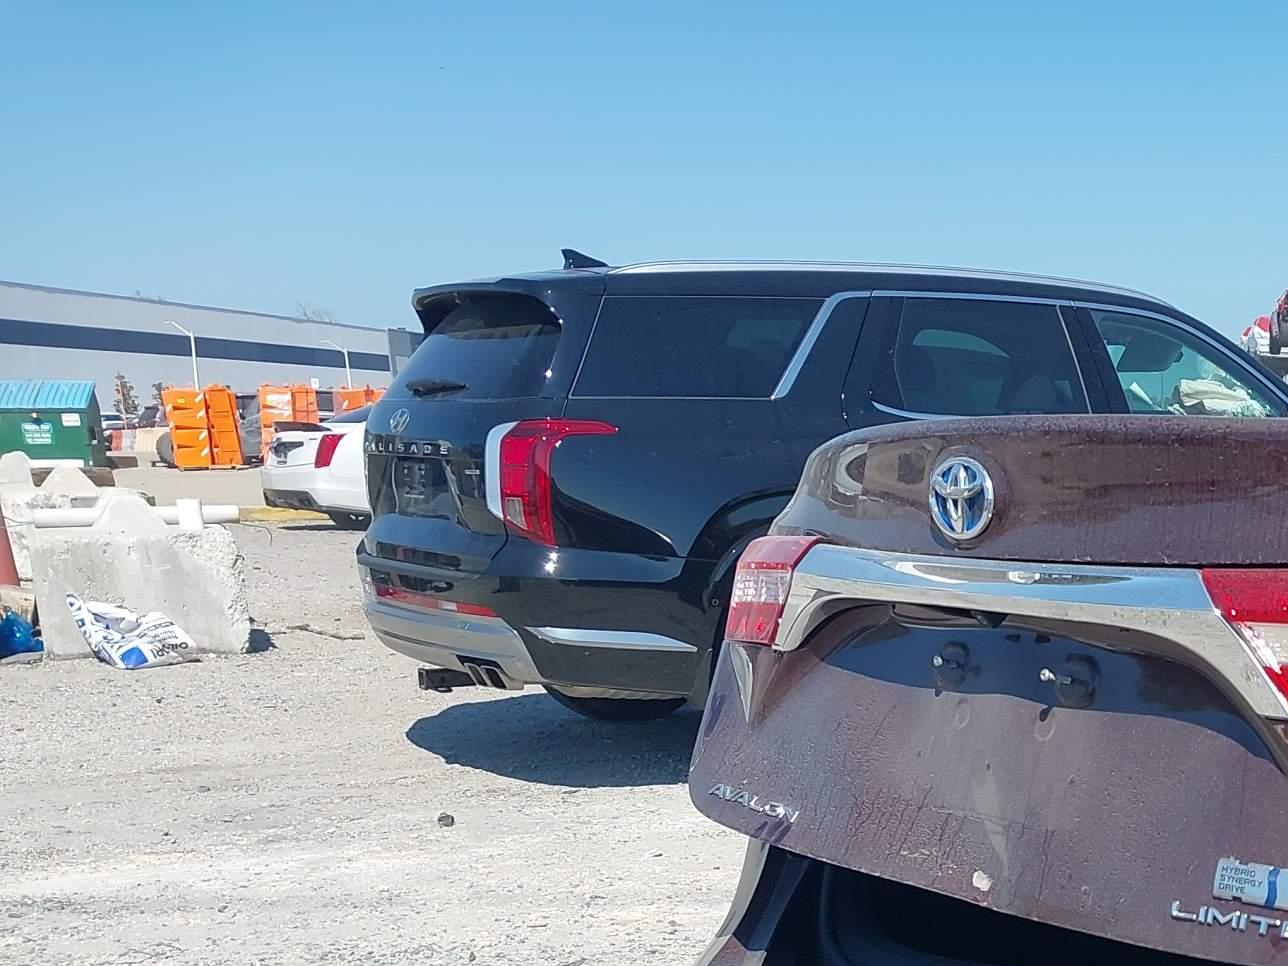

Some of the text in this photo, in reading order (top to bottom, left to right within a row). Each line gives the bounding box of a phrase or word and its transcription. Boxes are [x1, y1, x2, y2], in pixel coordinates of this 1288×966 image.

[708, 783, 800, 824] AVALON
[1221, 864, 1257, 879] HYBRID
[1218, 882, 1247, 895] DRIVE
[1219, 873, 1264, 889] SYNERGY
